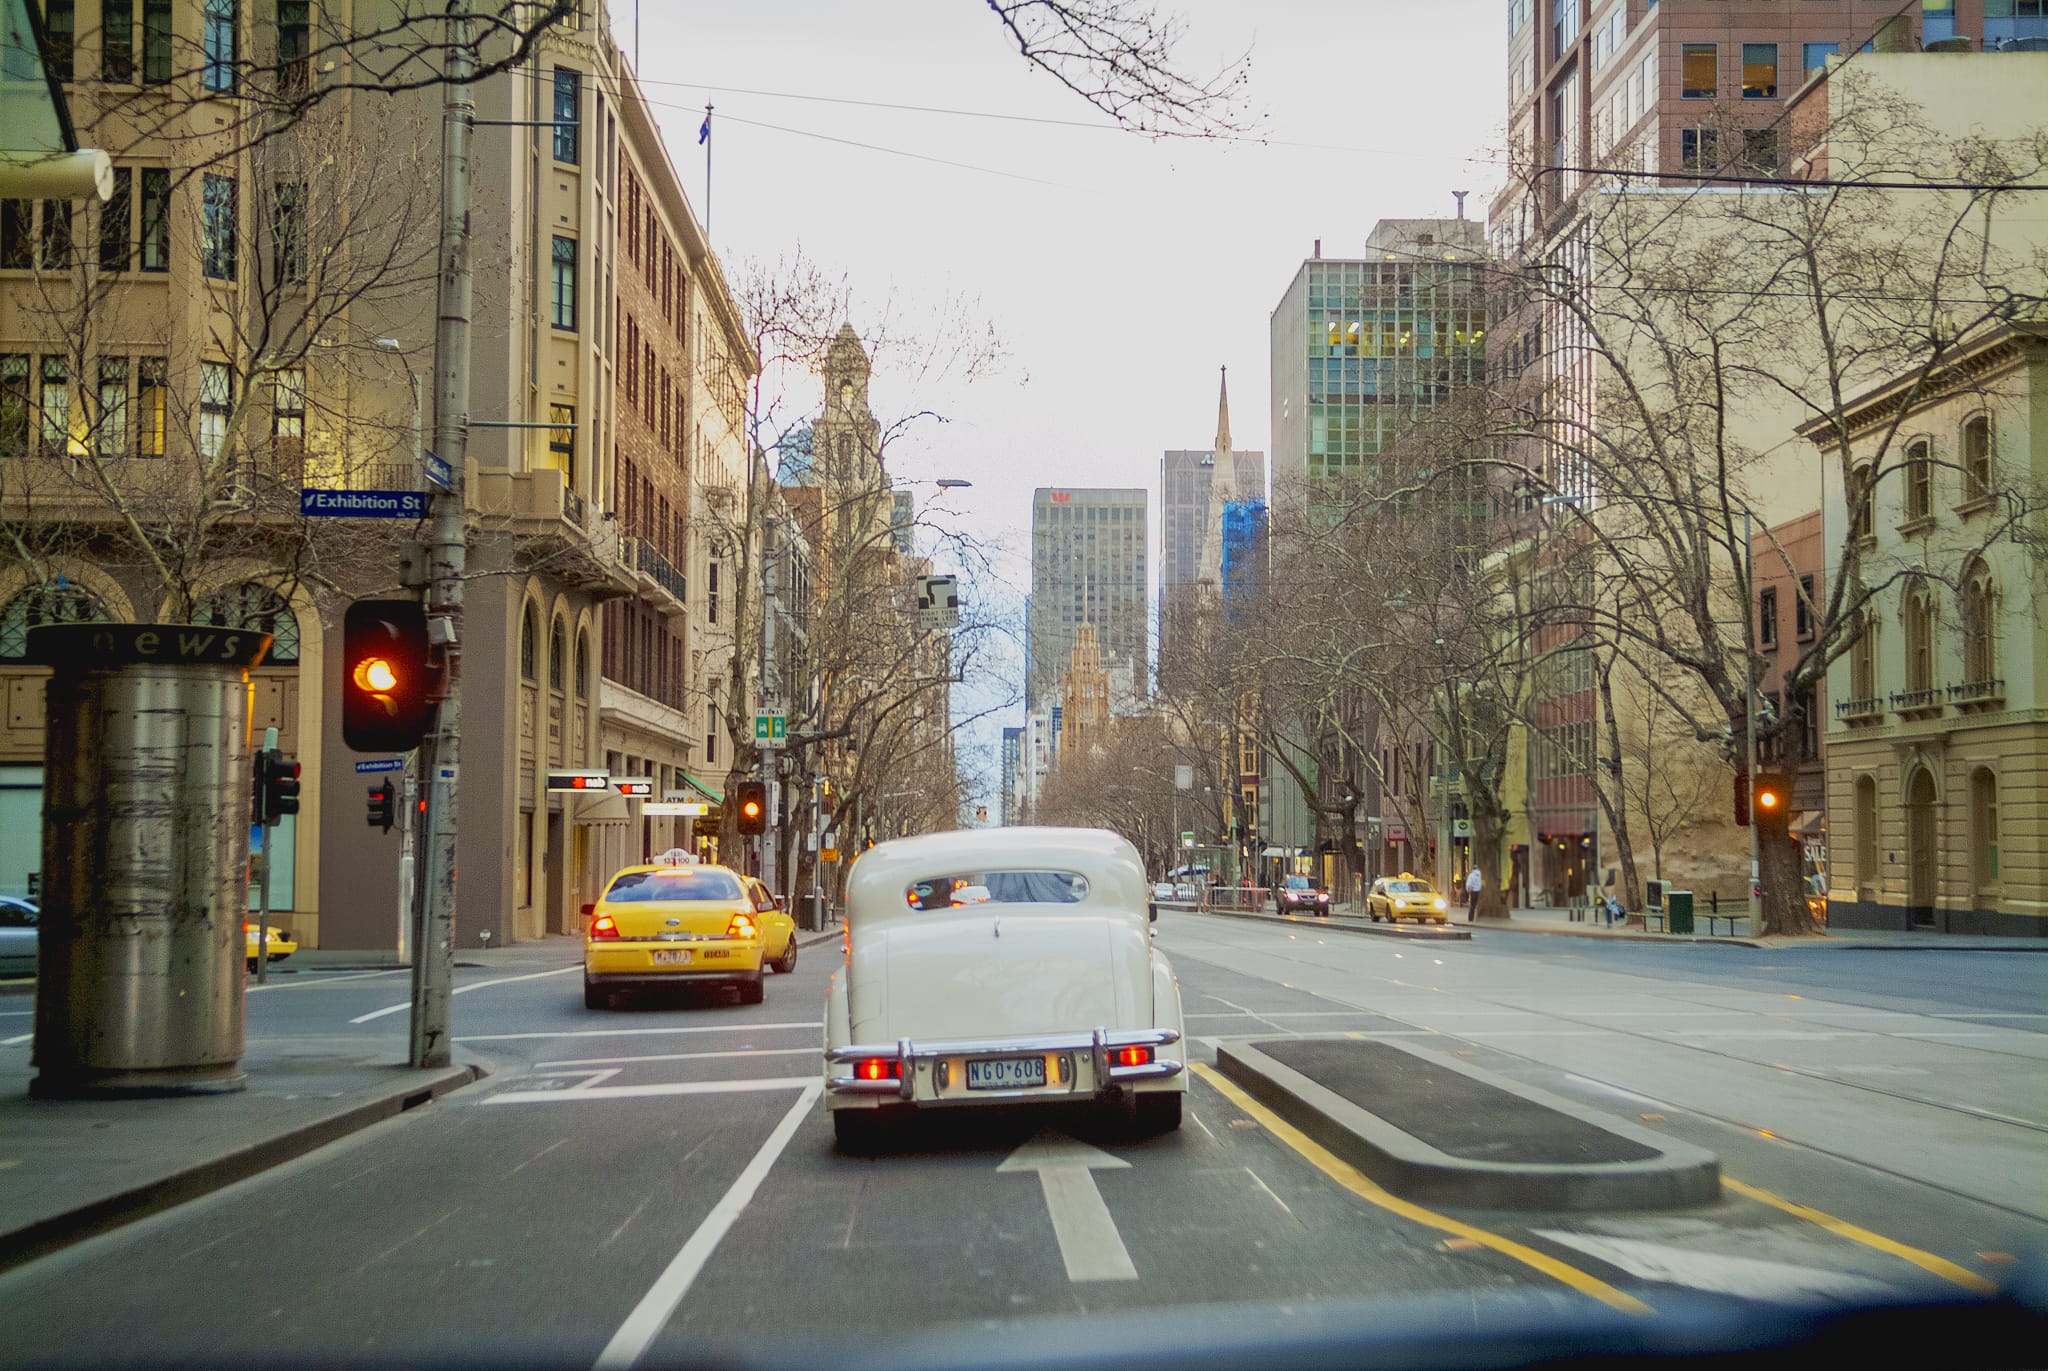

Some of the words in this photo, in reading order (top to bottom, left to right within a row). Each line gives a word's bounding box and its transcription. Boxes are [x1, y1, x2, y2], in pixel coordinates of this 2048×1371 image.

[316, 494, 398, 509] Exhibition
[401, 495, 421, 510] St
[93, 631, 240, 659] news
[362, 761, 393, 770] Exhibition
[585, 776, 606, 788] nab
[631, 783, 650, 794] nab
[666, 796, 685, 804] ATM
[1803, 845, 1827, 862] SALE
